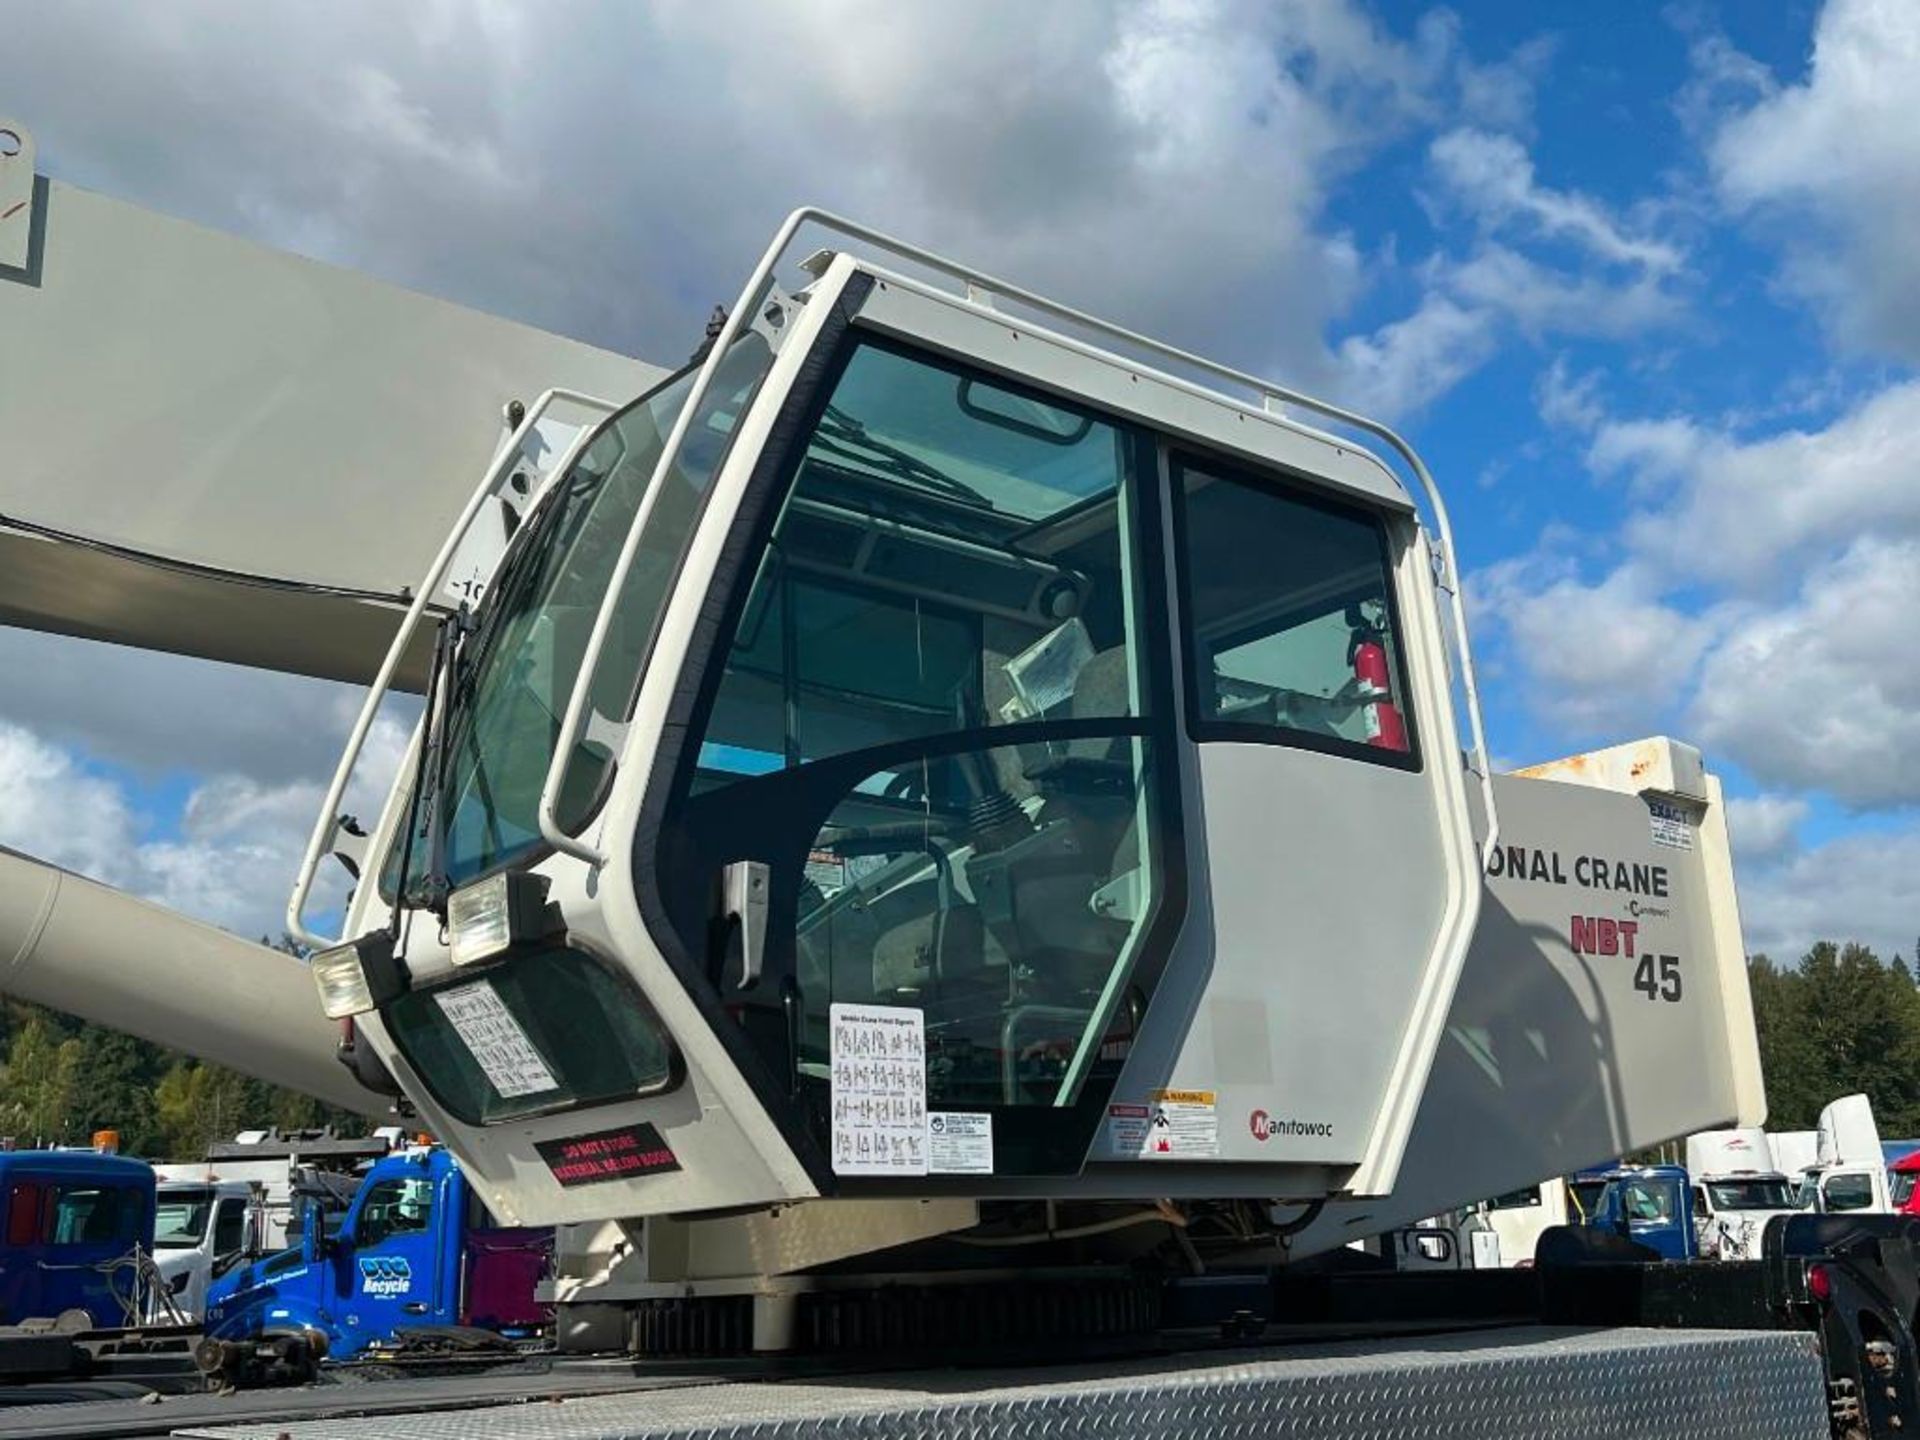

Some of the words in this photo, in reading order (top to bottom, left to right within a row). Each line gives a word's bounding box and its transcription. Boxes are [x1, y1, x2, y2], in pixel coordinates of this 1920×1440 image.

[1574, 855, 1669, 898] CRANE
[1571, 915, 1638, 959] NBT
[1633, 953, 1683, 1004] 45
[1251, 1111, 1333, 1139] Manitowoc
[362, 1279, 411, 1296] Recycle
